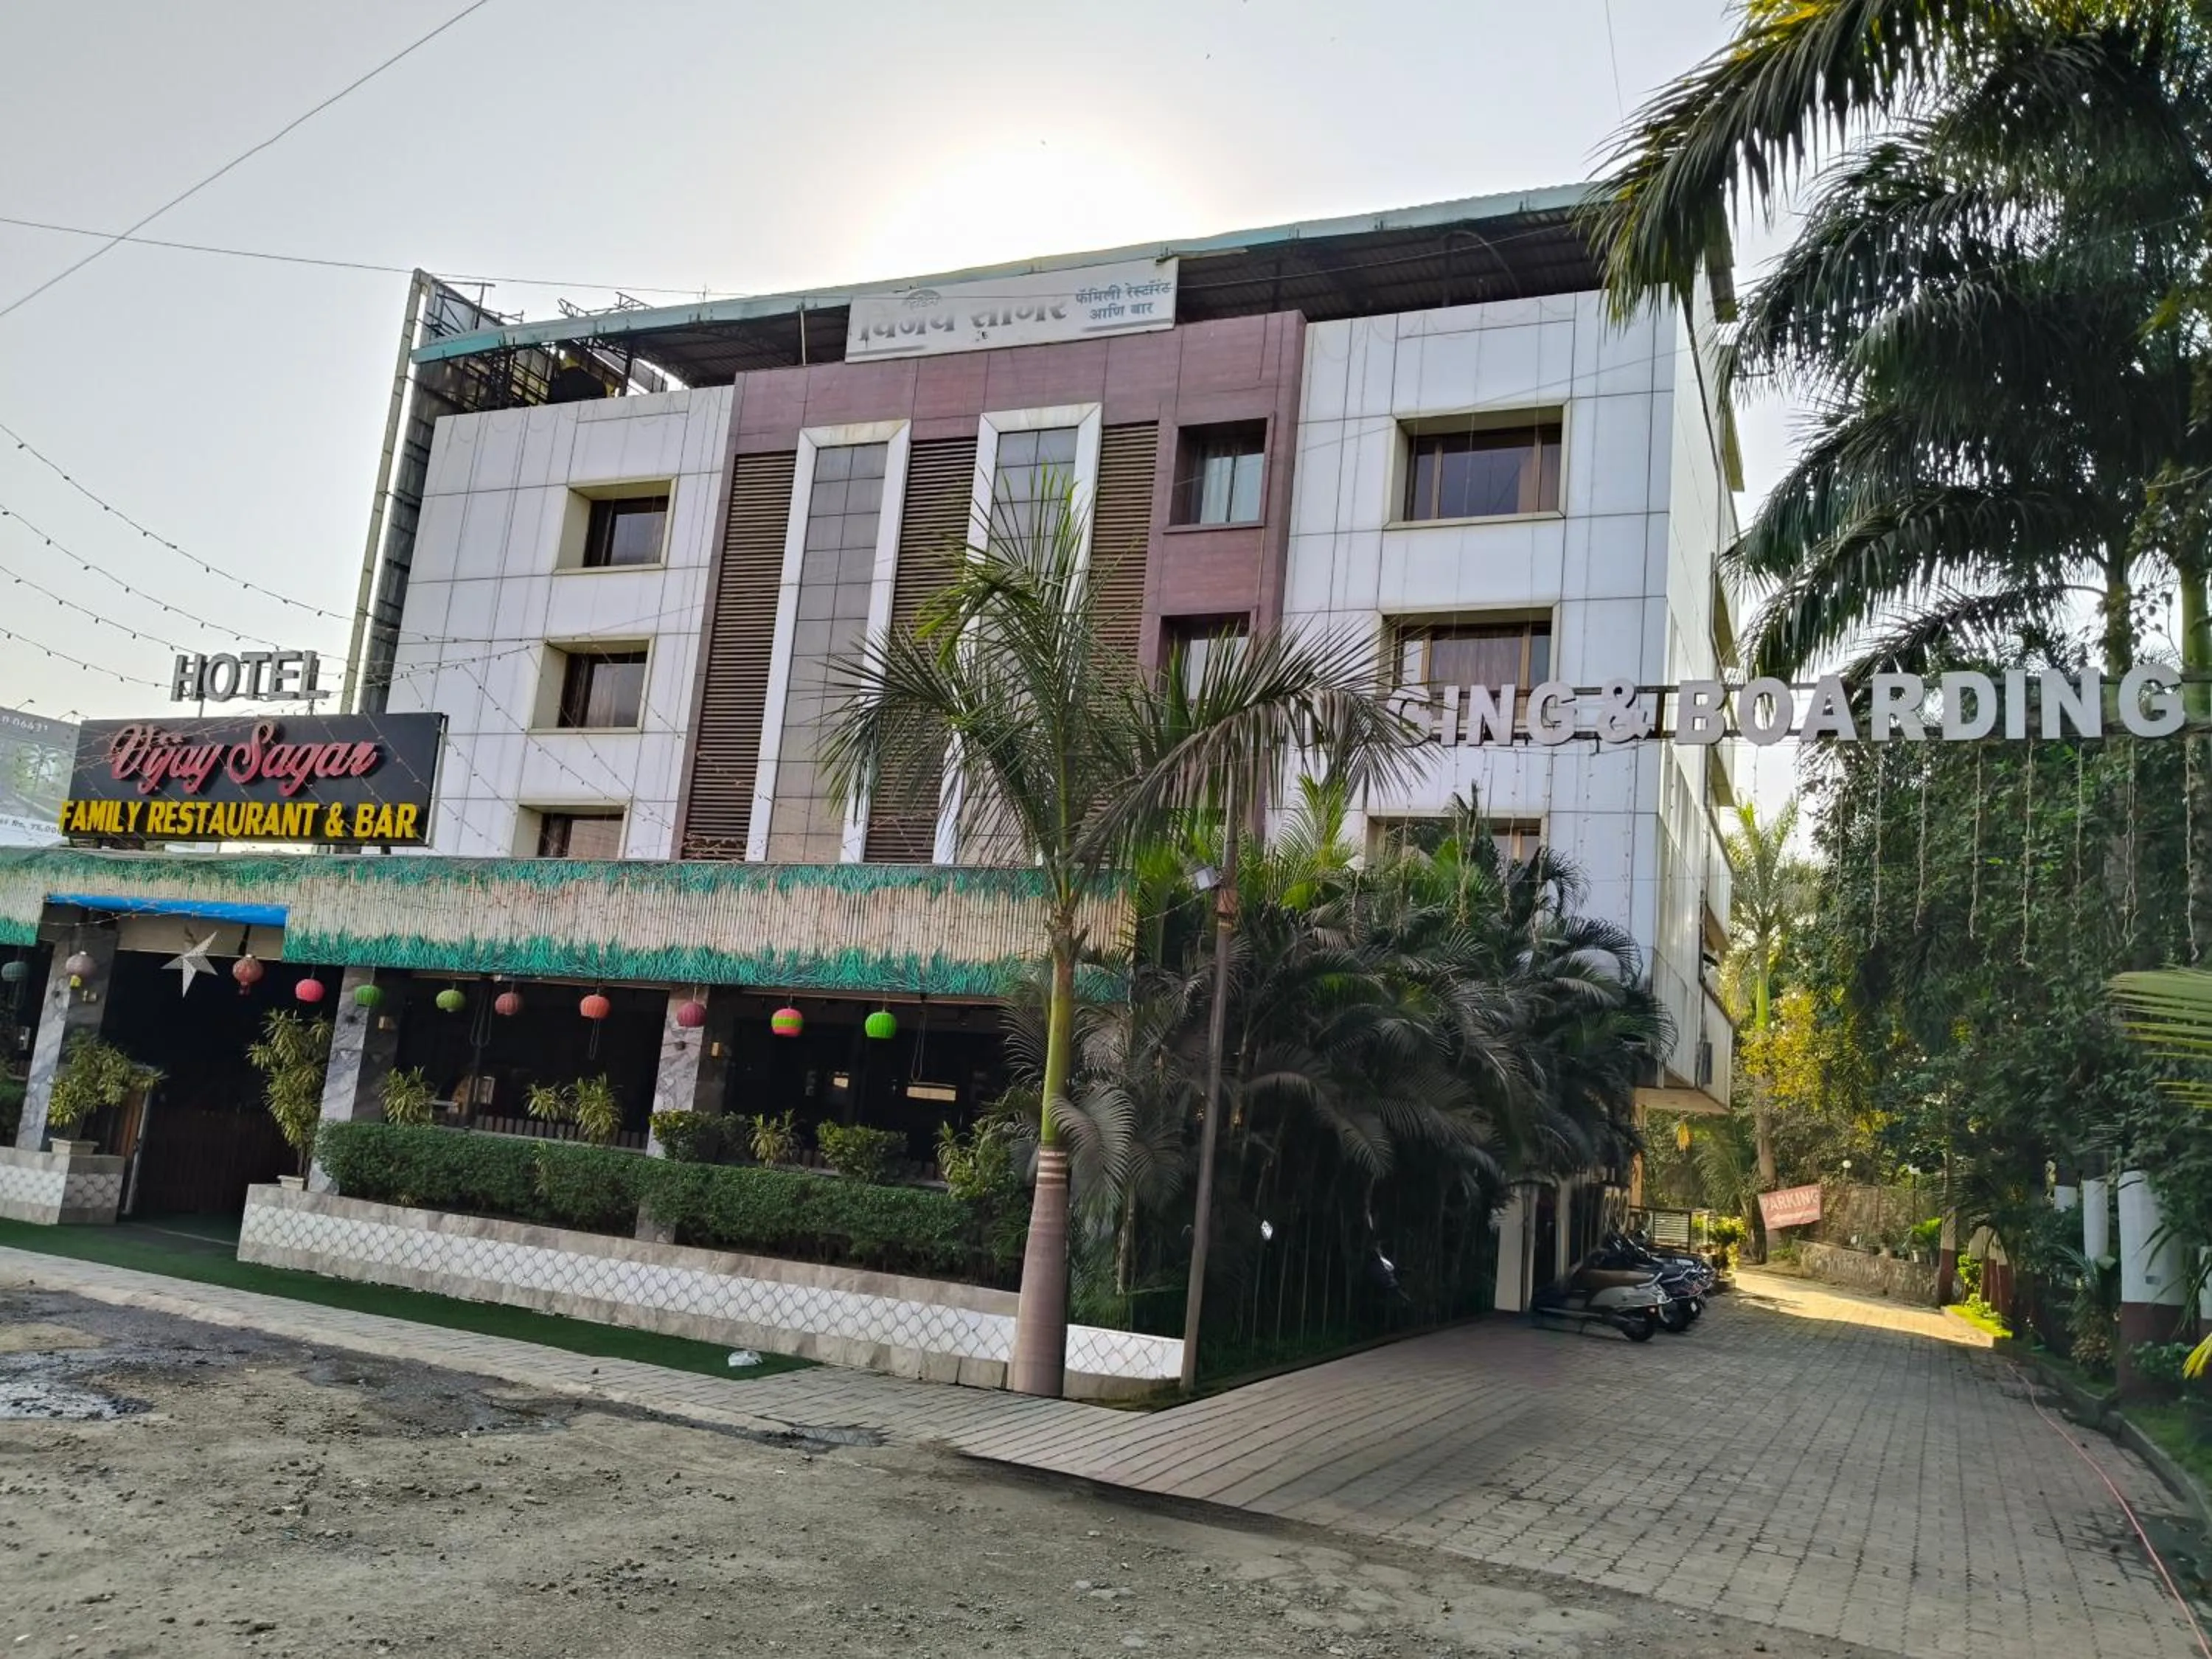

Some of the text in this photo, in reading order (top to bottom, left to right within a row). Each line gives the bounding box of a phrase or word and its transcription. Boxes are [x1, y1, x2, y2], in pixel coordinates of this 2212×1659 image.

[1090, 302, 1125, 320] आणि
[170, 650, 330, 702] HOTEL
[1596, 678, 1658, 744] &
[1674, 664, 2186, 746] BOARDING
[110, 719, 379, 797] Vijay Sagar
[58, 800, 143, 833] FAMILY
[146, 801, 319, 837] RESTAURANT
[324, 801, 344, 838] &
[353, 802, 417, 839] BAR
[1762, 1189, 1819, 1211] PARKING
